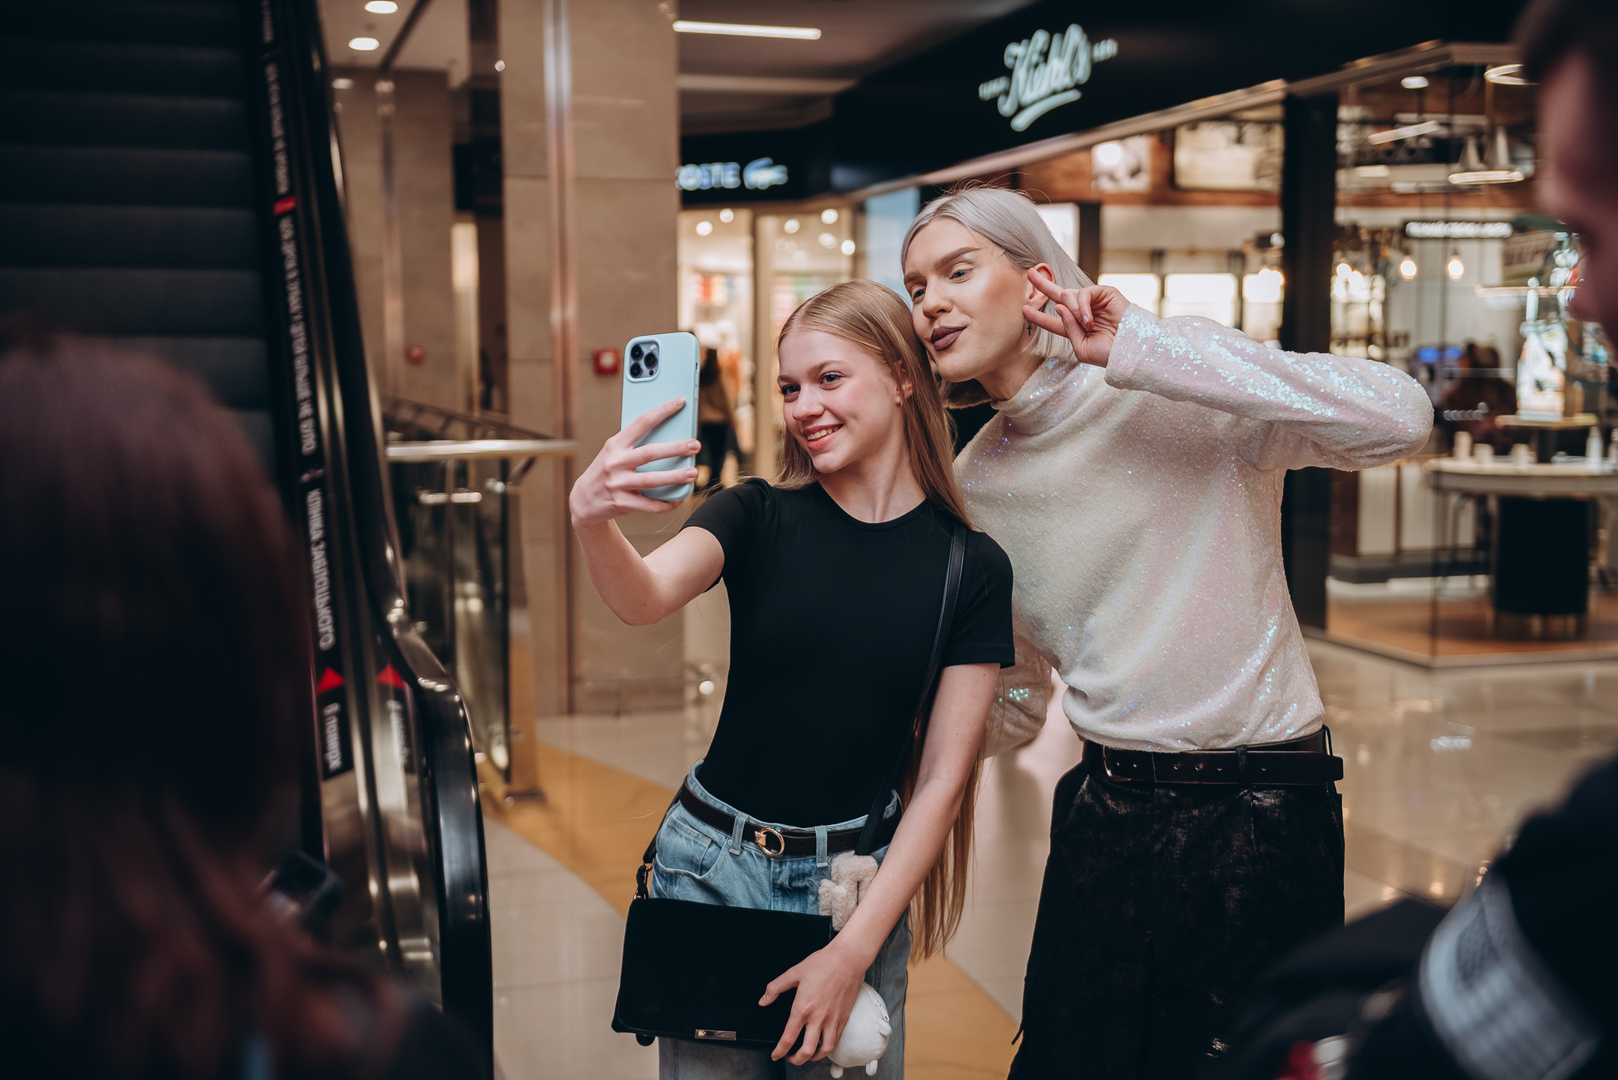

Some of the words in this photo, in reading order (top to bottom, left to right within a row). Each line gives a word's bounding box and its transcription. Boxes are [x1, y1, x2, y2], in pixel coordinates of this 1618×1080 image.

[997, 23, 1093, 118] Kiehl's
[675, 161, 741, 191] OSTE
[300, 419, 317, 455] БУЛО
[306, 487, 326, 544] КЛІНІКА
[311, 542, 335, 650] ЗАБЛОЦЬКОГО
[323, 702, 341, 720] 6
[324, 718, 343, 771] поверх
